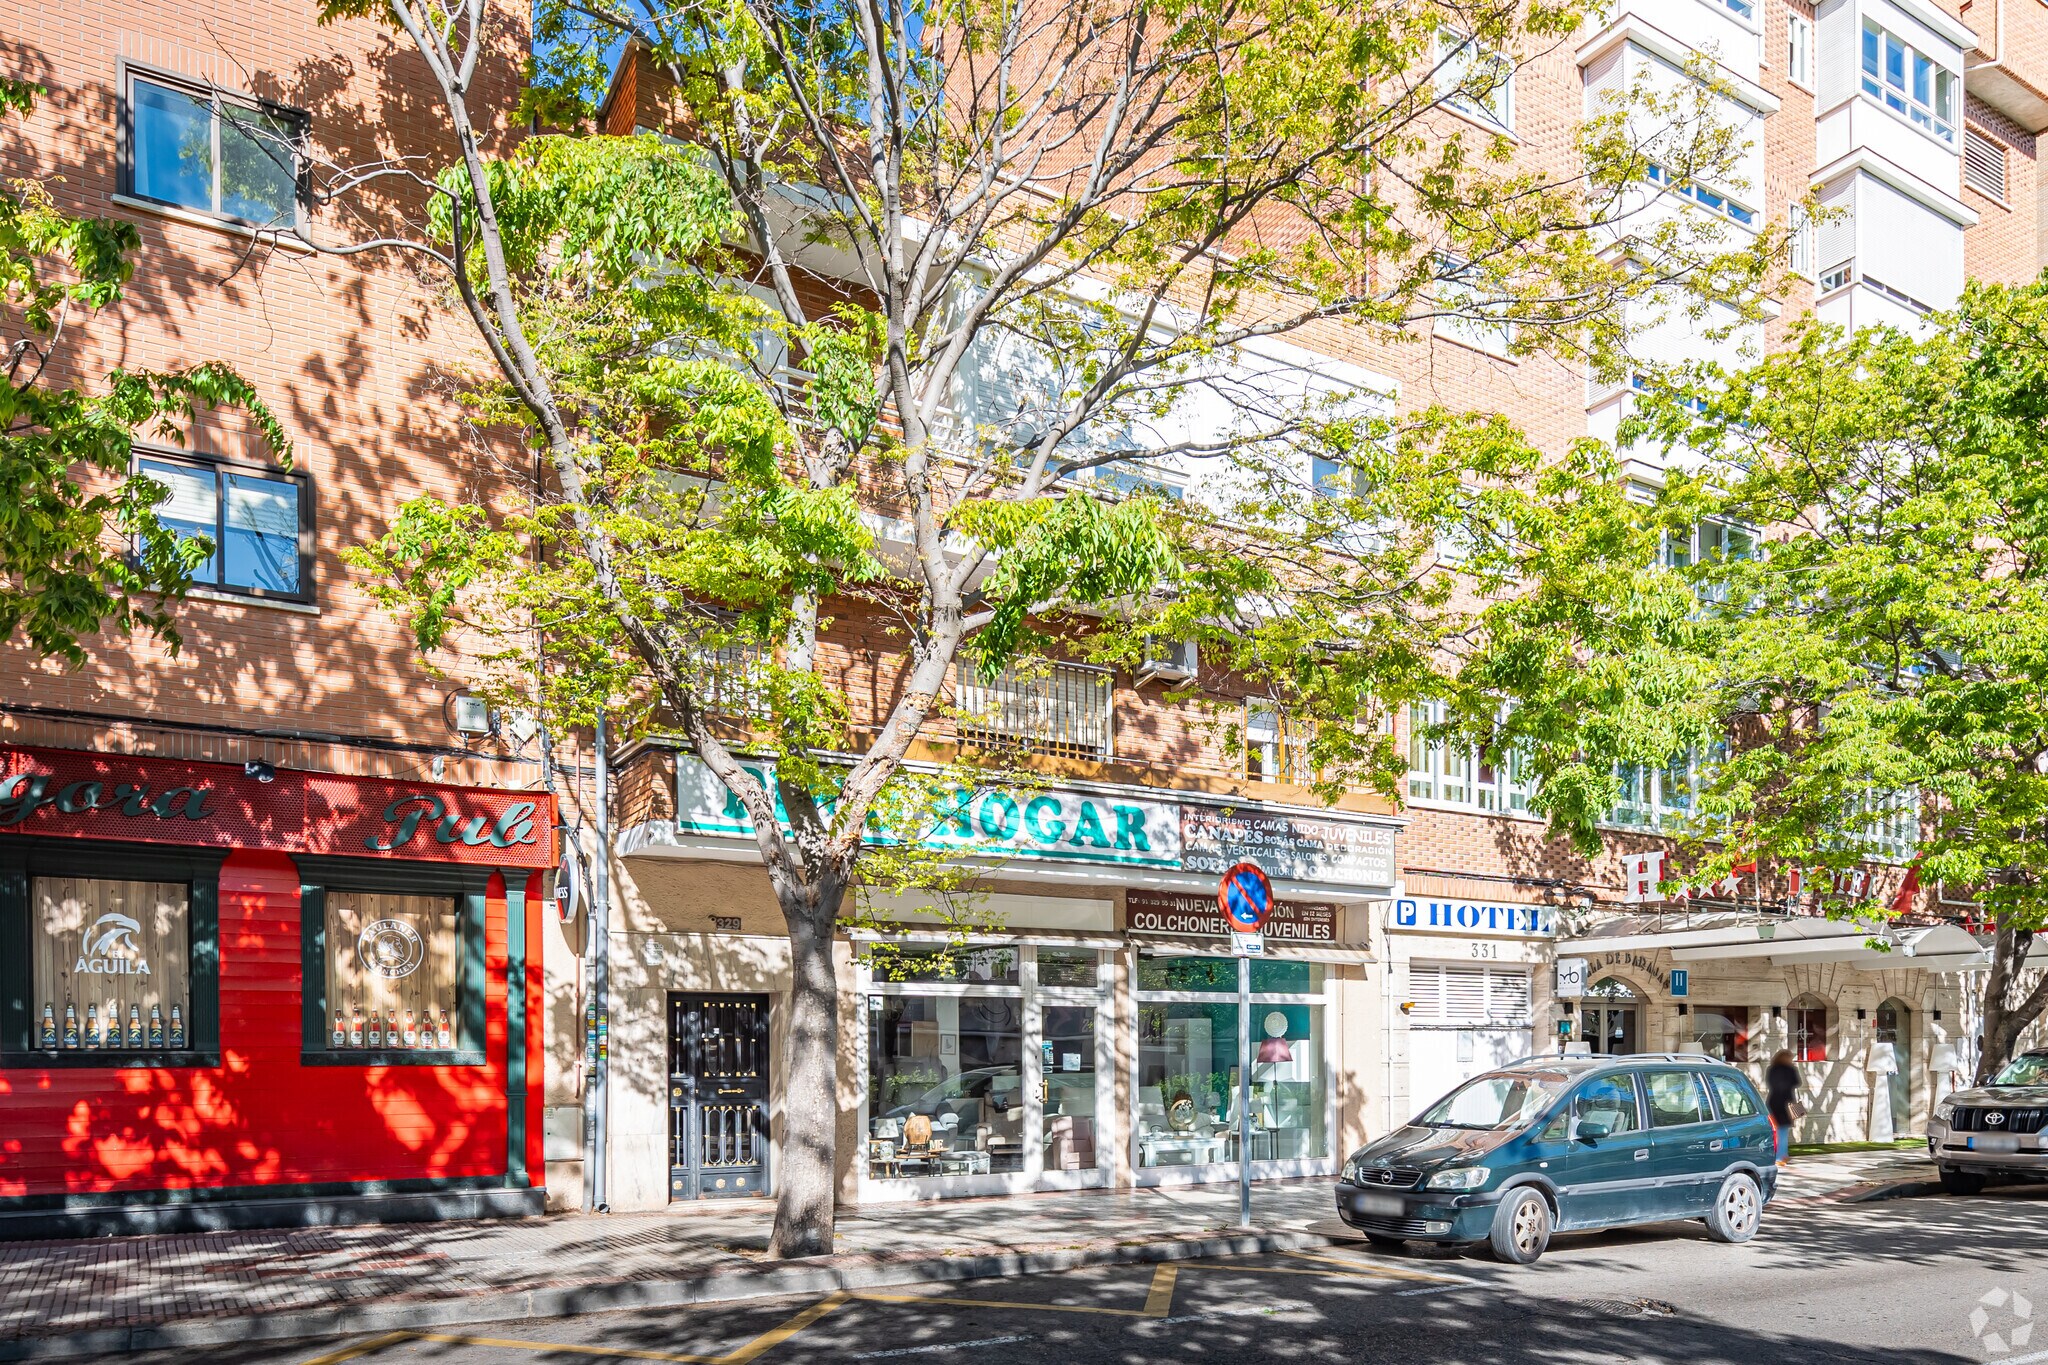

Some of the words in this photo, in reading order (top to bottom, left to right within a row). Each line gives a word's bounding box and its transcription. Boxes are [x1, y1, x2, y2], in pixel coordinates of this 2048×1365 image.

[364, 795, 536, 850] Pub
[927, 784, 1151, 851] HOGAR
[1184, 813, 1251, 826] INTERIORISMO
[1253, 819, 1289, 832] CAMAS
[1291, 823, 1319, 835] NIDO
[1321, 826, 1391, 845] JUVENILES
[1184, 823, 1264, 844] CANAPÉS
[1264, 835, 1295, 847] SOFÁS
[1296, 838, 1324, 850] CAMA
[1326, 842, 1392, 856] DECORACIÓN
[1185, 841, 1222, 854] CAMAS
[1226, 844, 1287, 859] VERTICALES
[1291, 851, 1328, 863] SALONES
[1331, 854, 1387, 868] COMPACTOS
[1308, 865, 1389, 882] COLCHONES
[1622, 851, 1669, 904] H
[1176, 898, 1219, 913] NUEVA
[1429, 902, 1550, 932] HOTEL
[363, 922, 418, 943] PAULANER
[717, 918, 740, 930] 329
[1471, 943, 1498, 959] 331
[1606, 952, 1621, 965] DE
[74, 955, 151, 975] ÁGUILA
